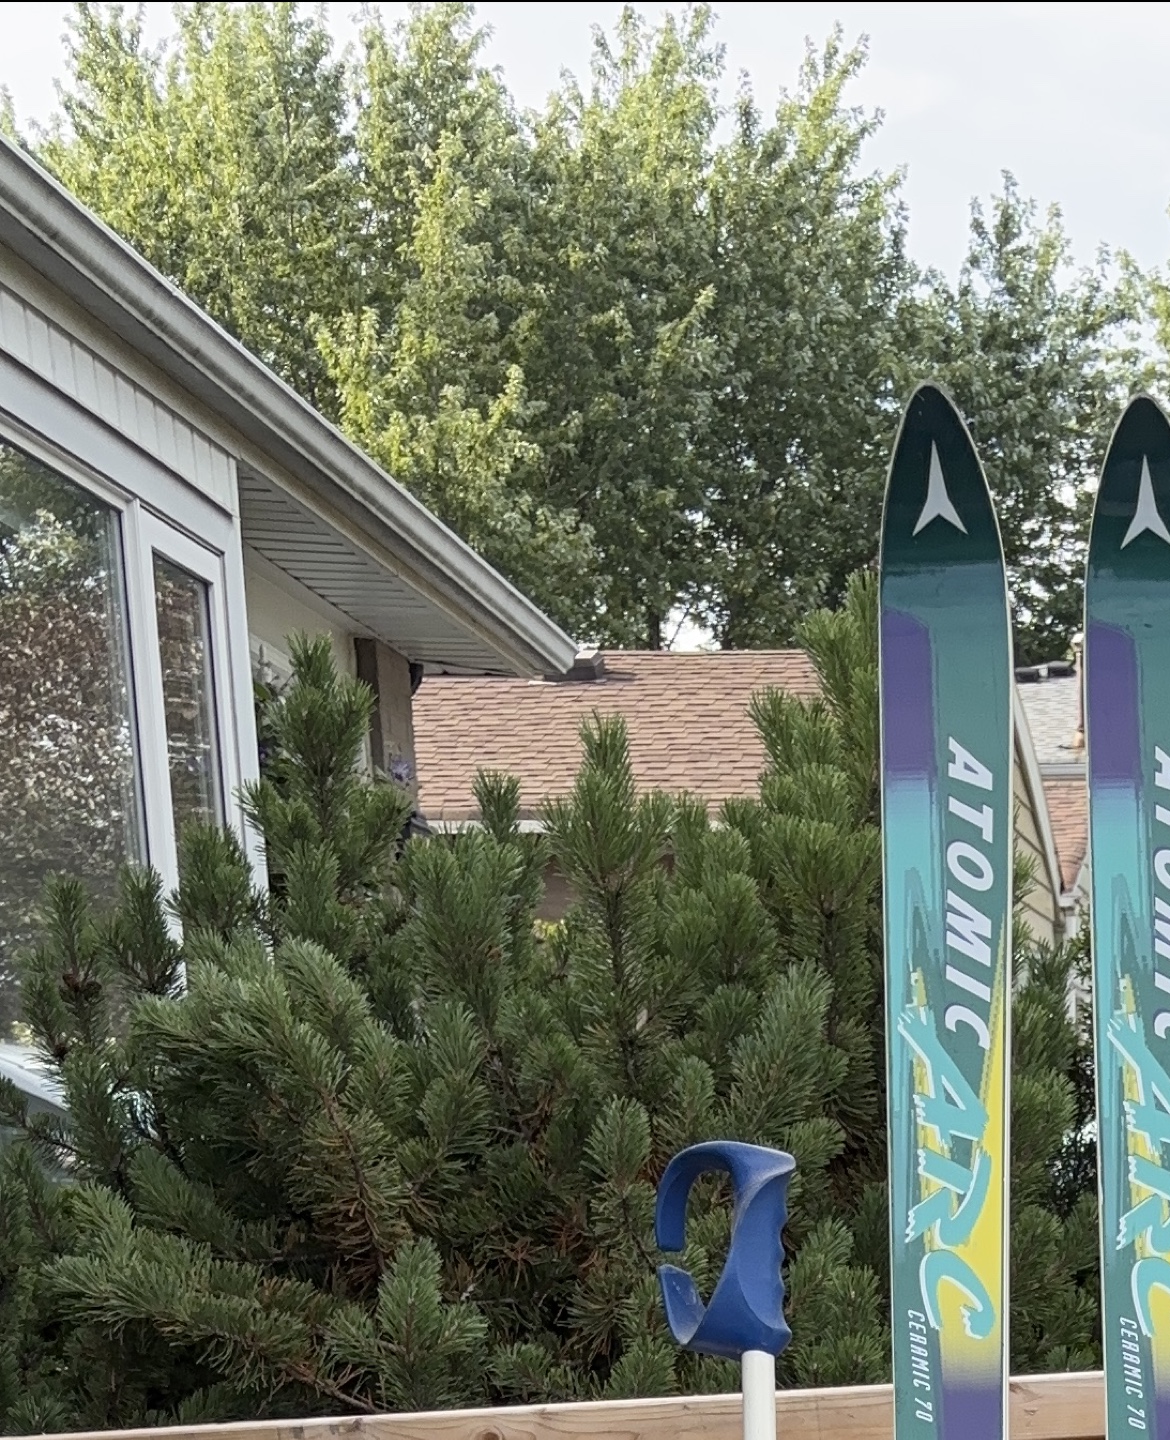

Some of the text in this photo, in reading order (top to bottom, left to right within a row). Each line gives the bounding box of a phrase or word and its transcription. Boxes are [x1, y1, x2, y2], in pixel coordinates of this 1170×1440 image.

[945, 736, 993, 1049] ATOMIC
[907, 1309, 934, 1423] CERAMIC 70
[1119, 1316, 1146, 1430] CERAMIC 70
